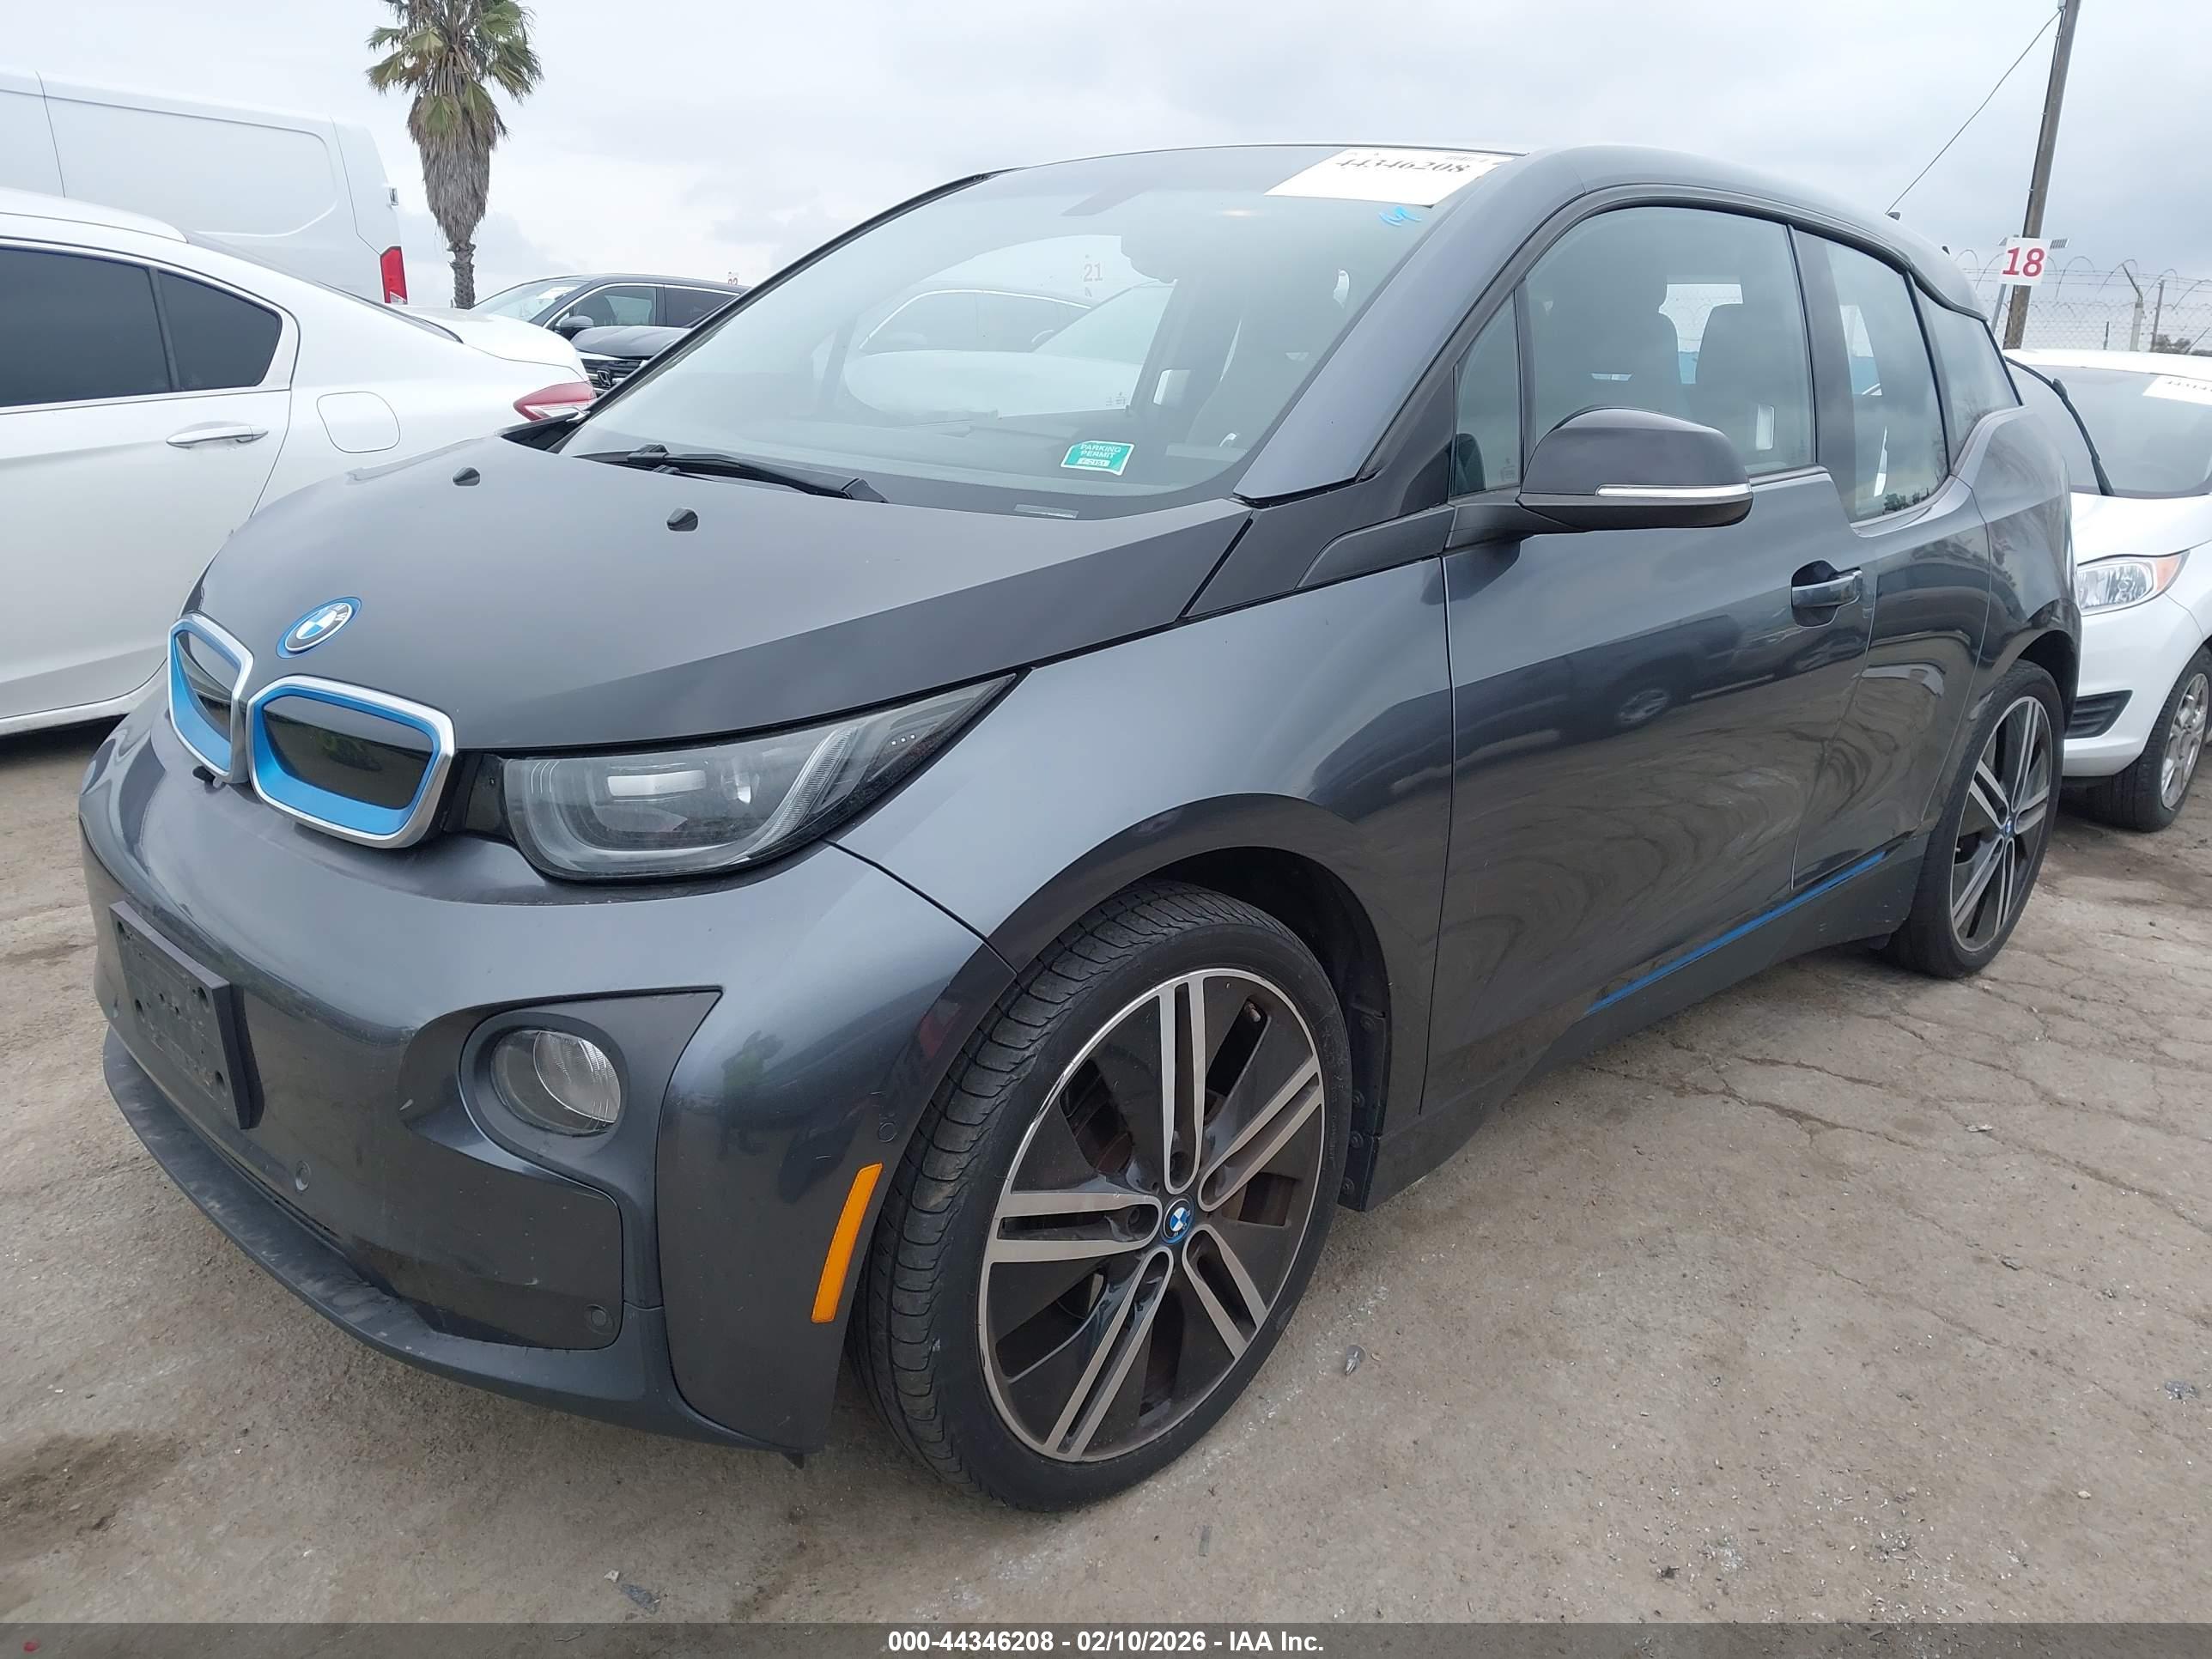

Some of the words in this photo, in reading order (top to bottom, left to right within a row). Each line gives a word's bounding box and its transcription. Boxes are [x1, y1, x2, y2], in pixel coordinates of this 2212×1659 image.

[1335, 159, 1470, 172] 44346208
[2002, 247, 2045, 276] 18
[1084, 262, 1103, 282] 21
